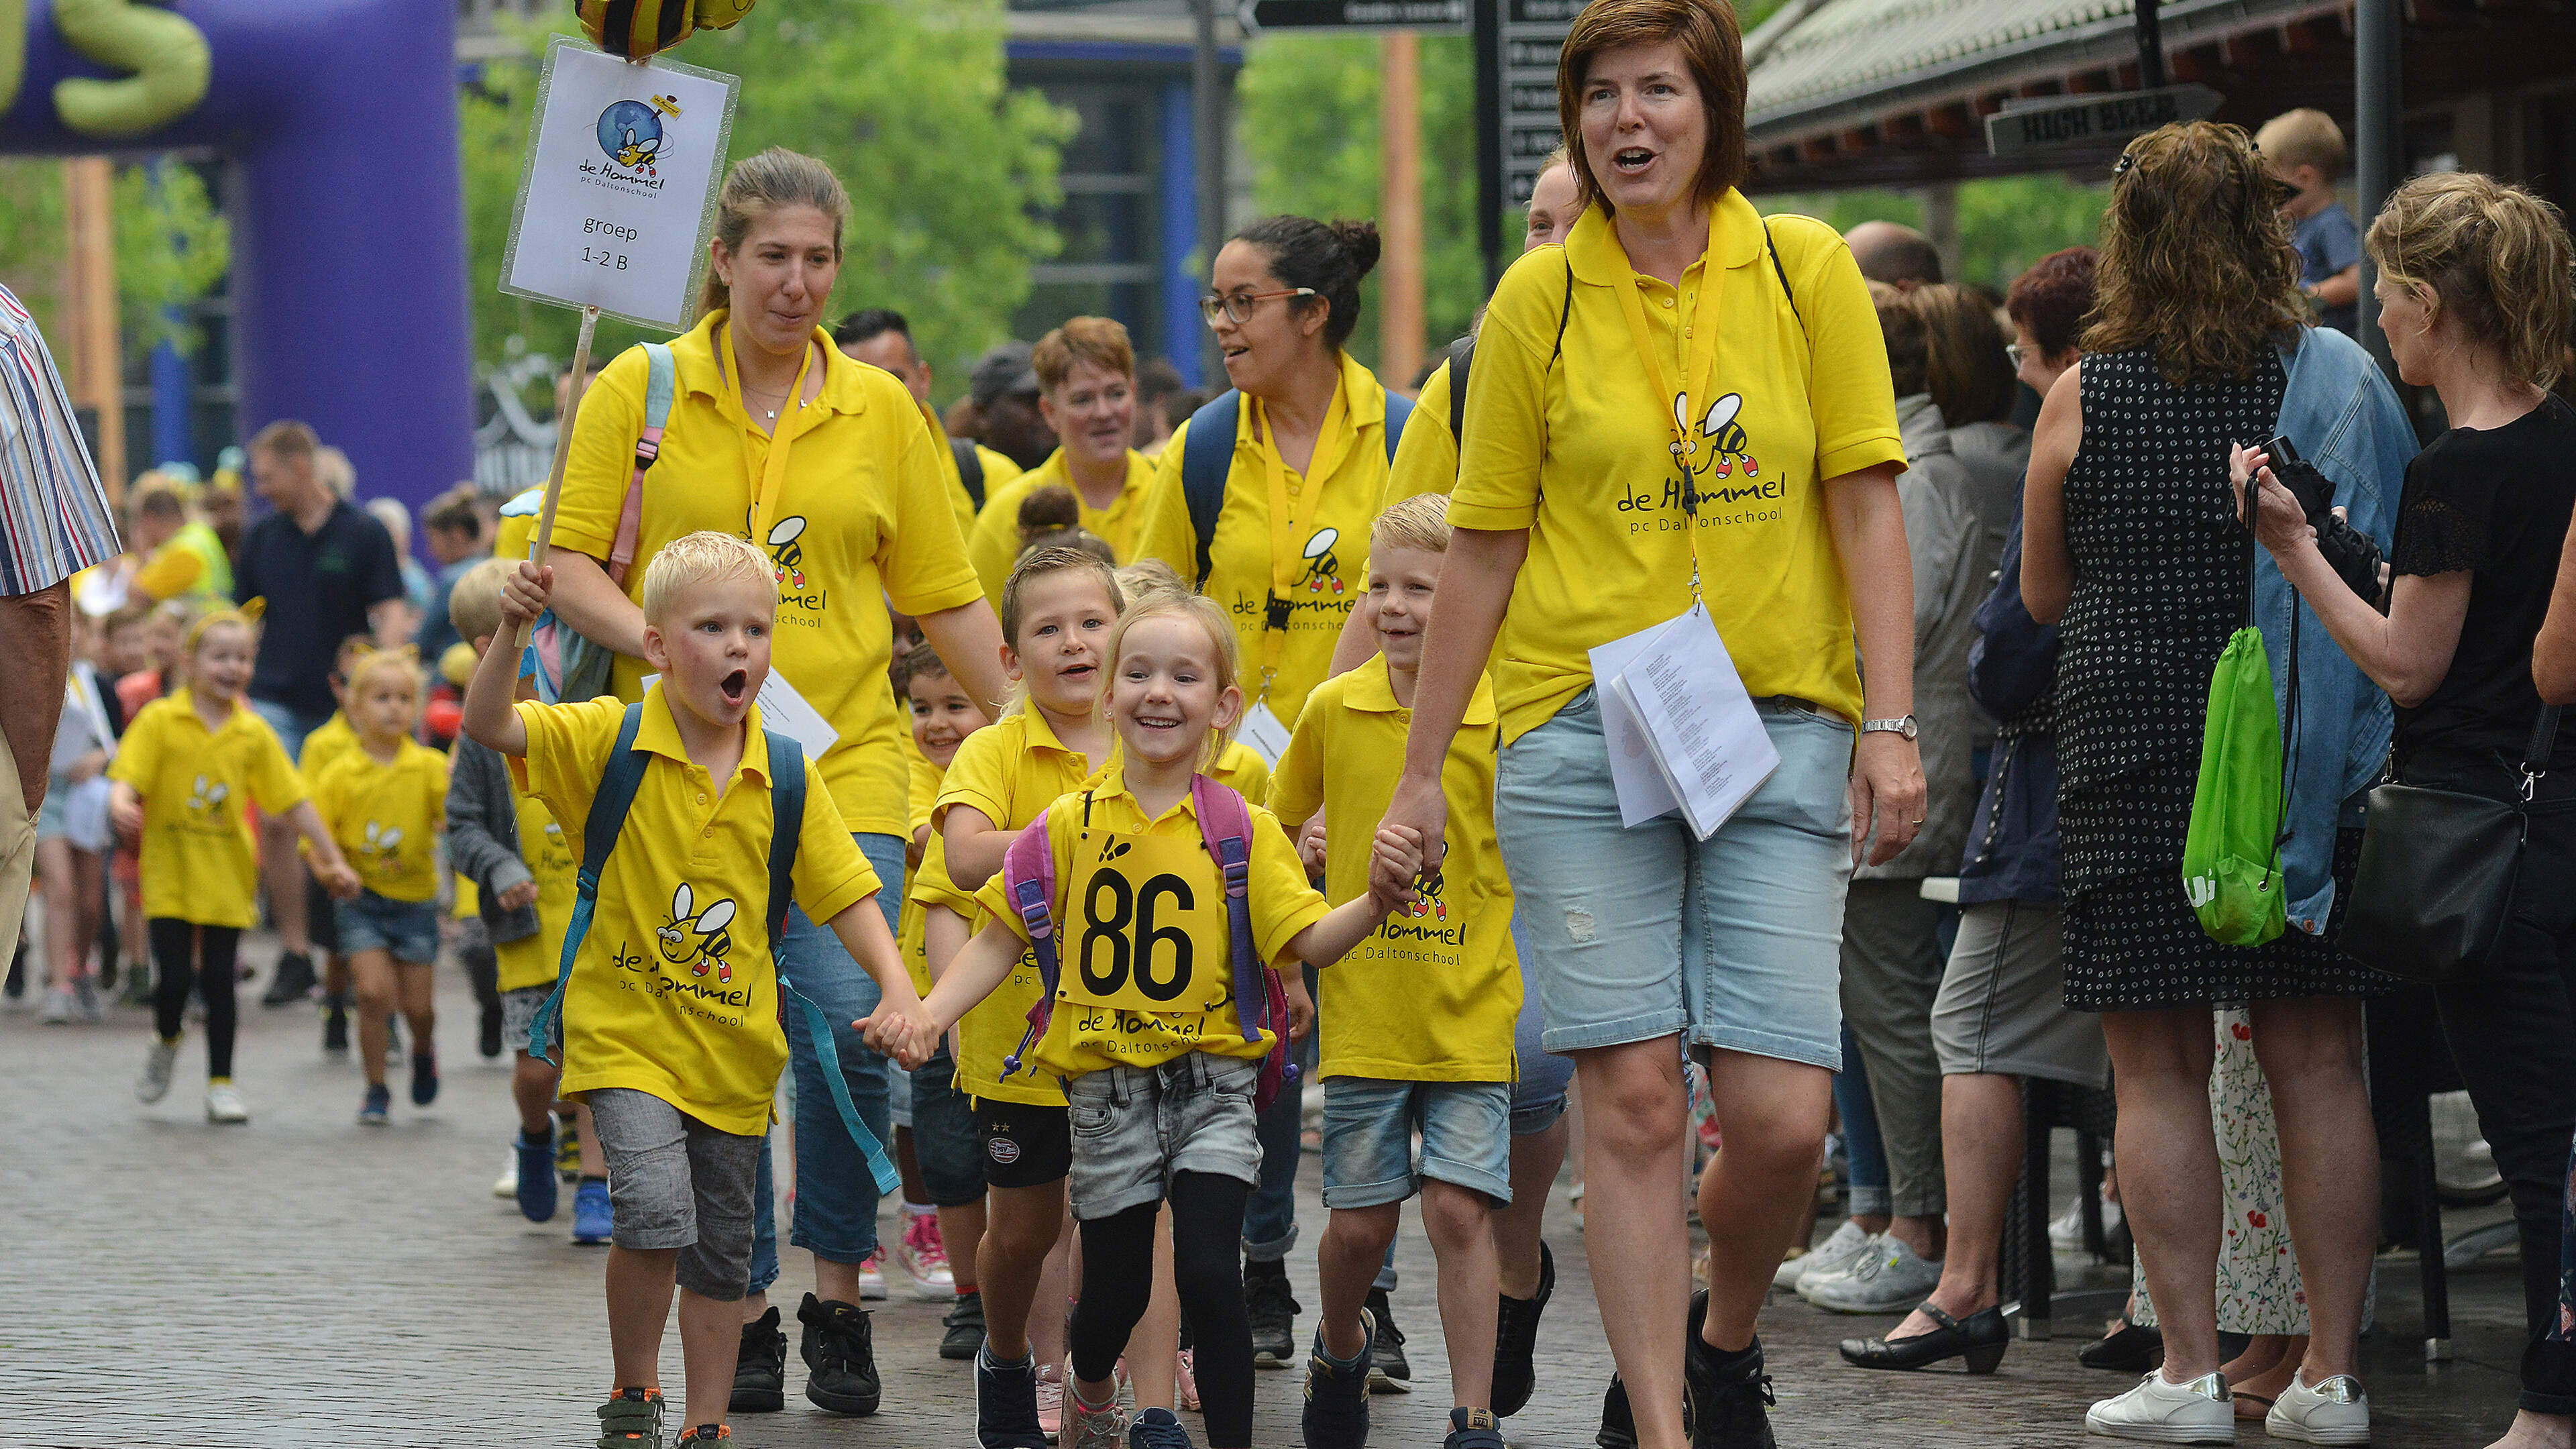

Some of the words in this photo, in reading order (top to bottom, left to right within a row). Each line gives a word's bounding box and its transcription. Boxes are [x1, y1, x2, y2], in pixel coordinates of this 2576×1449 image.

[0, 0, 210, 137] S
[579, 158, 597, 175] de
[600, 162, 665, 190] Hommel
[595, 178, 657, 199] Daltonschool
[583, 217, 637, 243] groep
[582, 247, 611, 267] 1-2
[616, 255, 628, 270] B
[1617, 482, 1654, 513] de
[1630, 521, 1649, 535] pc
[1660, 506, 1782, 531] Dalonschool
[778, 589, 826, 610] mel
[1233, 590, 1258, 614] de
[775, 614, 821, 628] school
[1240, 621, 1254, 631] pc
[1079, 867, 1195, 1002] 86
[612, 940, 643, 973] de
[1344, 950, 1357, 963] pc
[1366, 947, 1460, 965] Daltonschool
[1014, 974, 1032, 986] pc
[645, 982, 744, 1027] Danschool
[1078, 1008, 1106, 1032] de
[1474, 1418, 1487, 1426] 373
